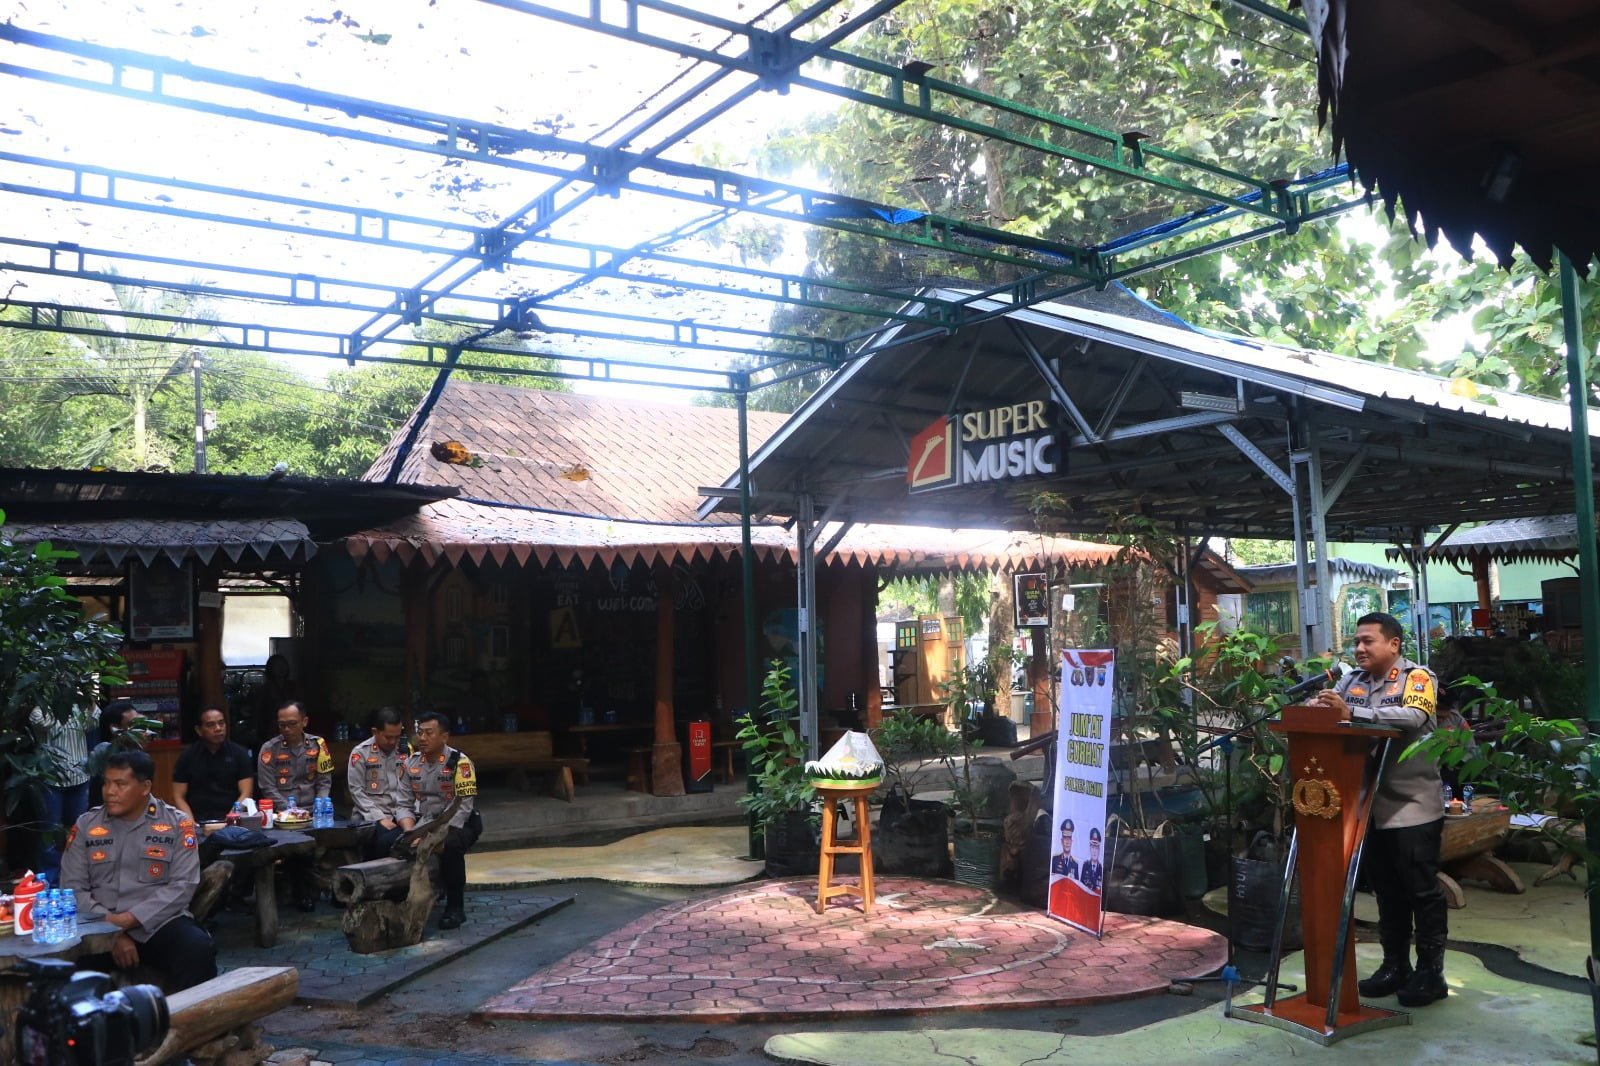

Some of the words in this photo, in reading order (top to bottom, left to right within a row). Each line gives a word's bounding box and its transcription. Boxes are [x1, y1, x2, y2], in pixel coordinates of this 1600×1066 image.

[962, 400, 1048, 442] SUPER
[962, 435, 1056, 484] MUSIC
[1345, 696, 1364, 705] ARGO
[1067, 739, 1105, 768] CURHAT
[144, 835, 174, 845] POLRI
